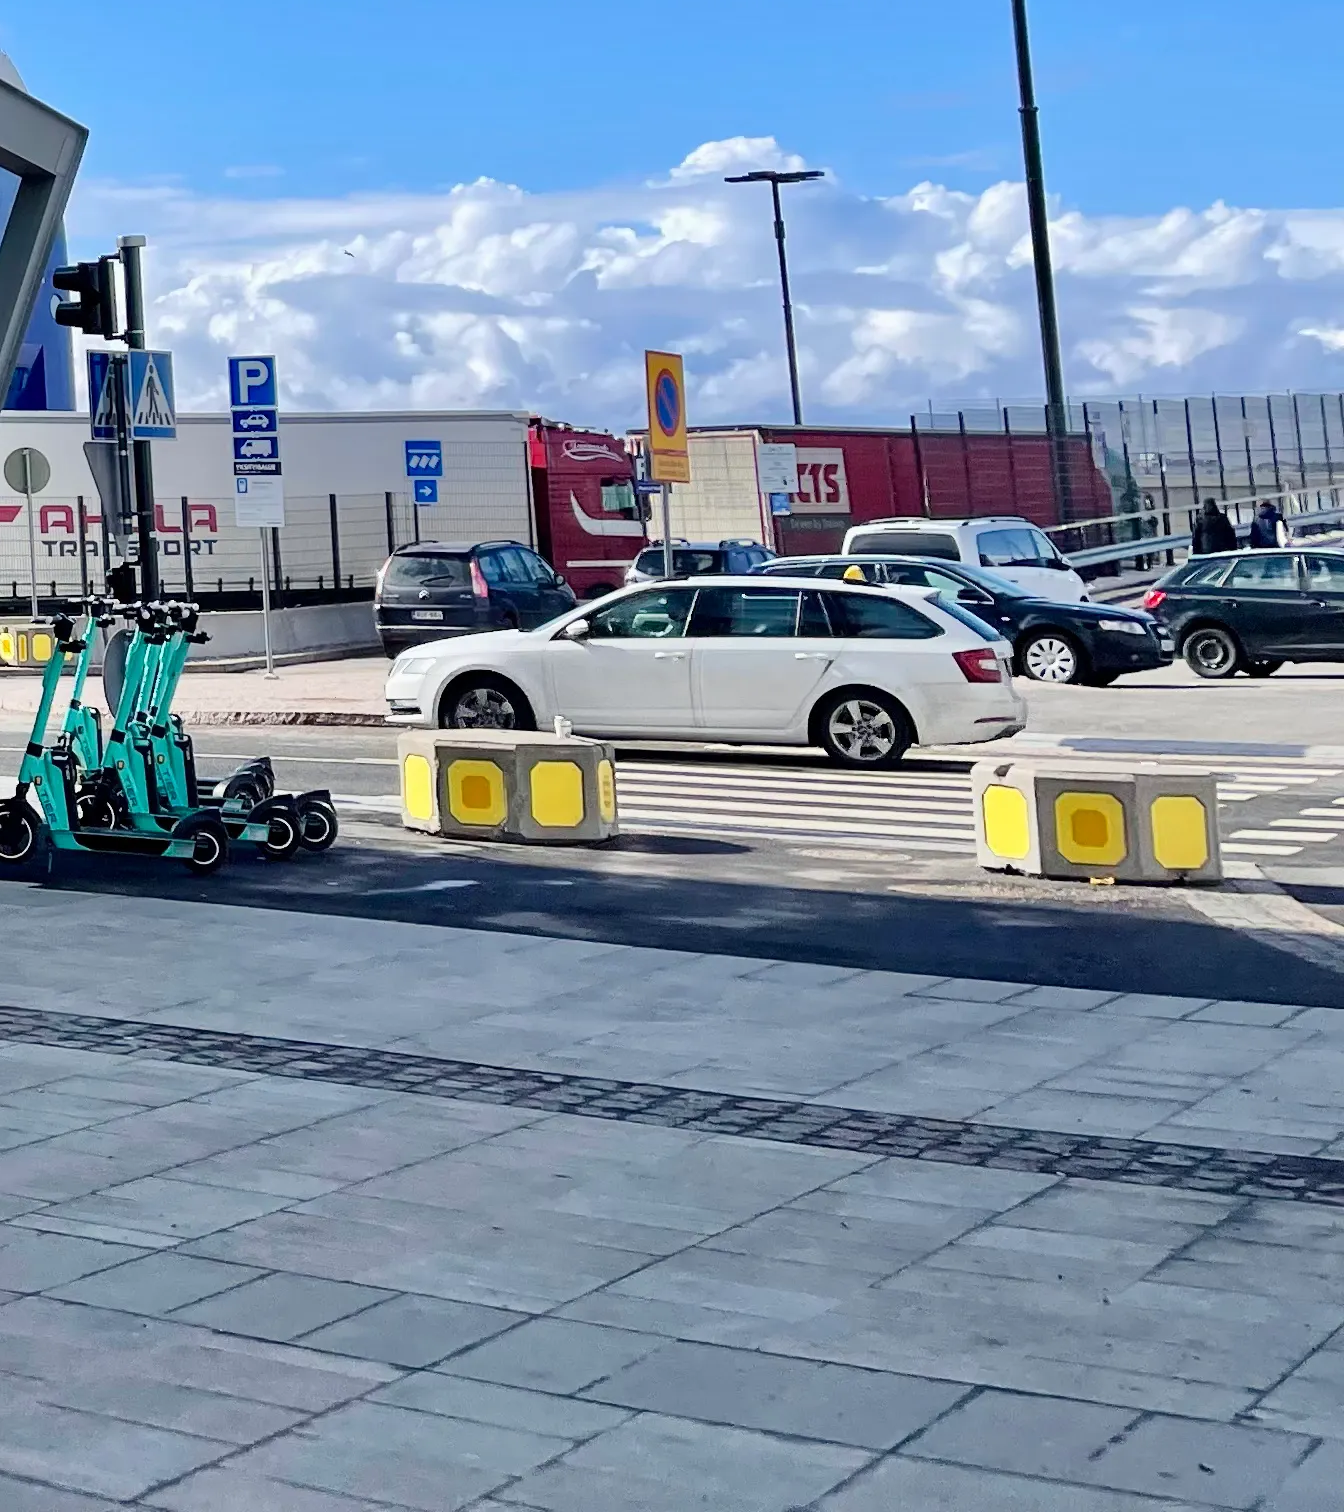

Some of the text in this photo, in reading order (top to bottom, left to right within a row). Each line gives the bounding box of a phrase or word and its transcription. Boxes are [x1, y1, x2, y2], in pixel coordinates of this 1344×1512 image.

[237, 360, 269, 404] P
[124, 774, 139, 808] TIER
[161, 768, 178, 801] TIER
[39, 791, 59, 824] TIER
